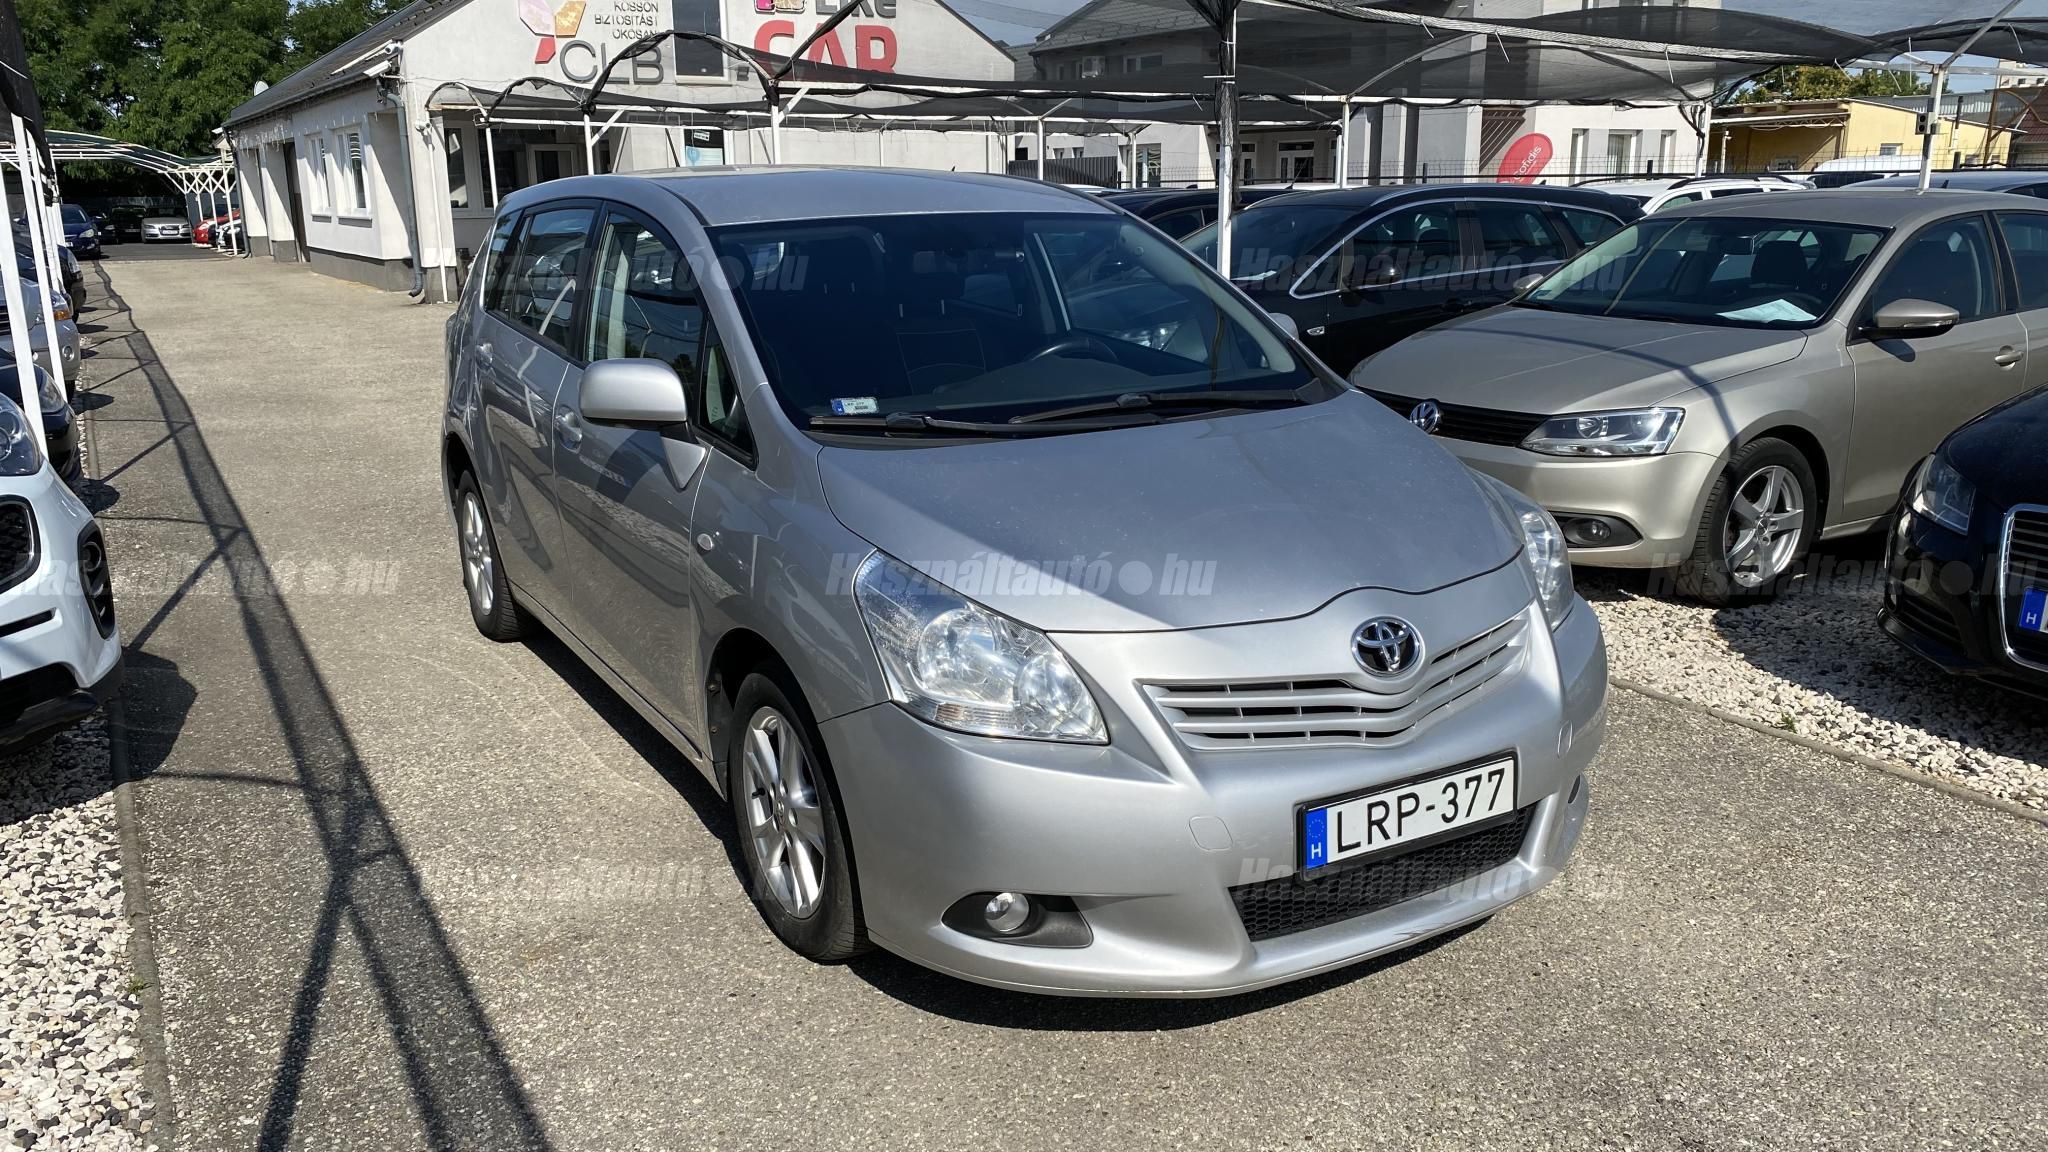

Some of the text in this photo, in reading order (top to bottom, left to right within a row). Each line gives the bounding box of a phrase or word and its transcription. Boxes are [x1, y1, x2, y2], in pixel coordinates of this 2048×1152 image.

[560, 40, 664, 85] CLB
[1310, 767, 1505, 860] H LRP-377
